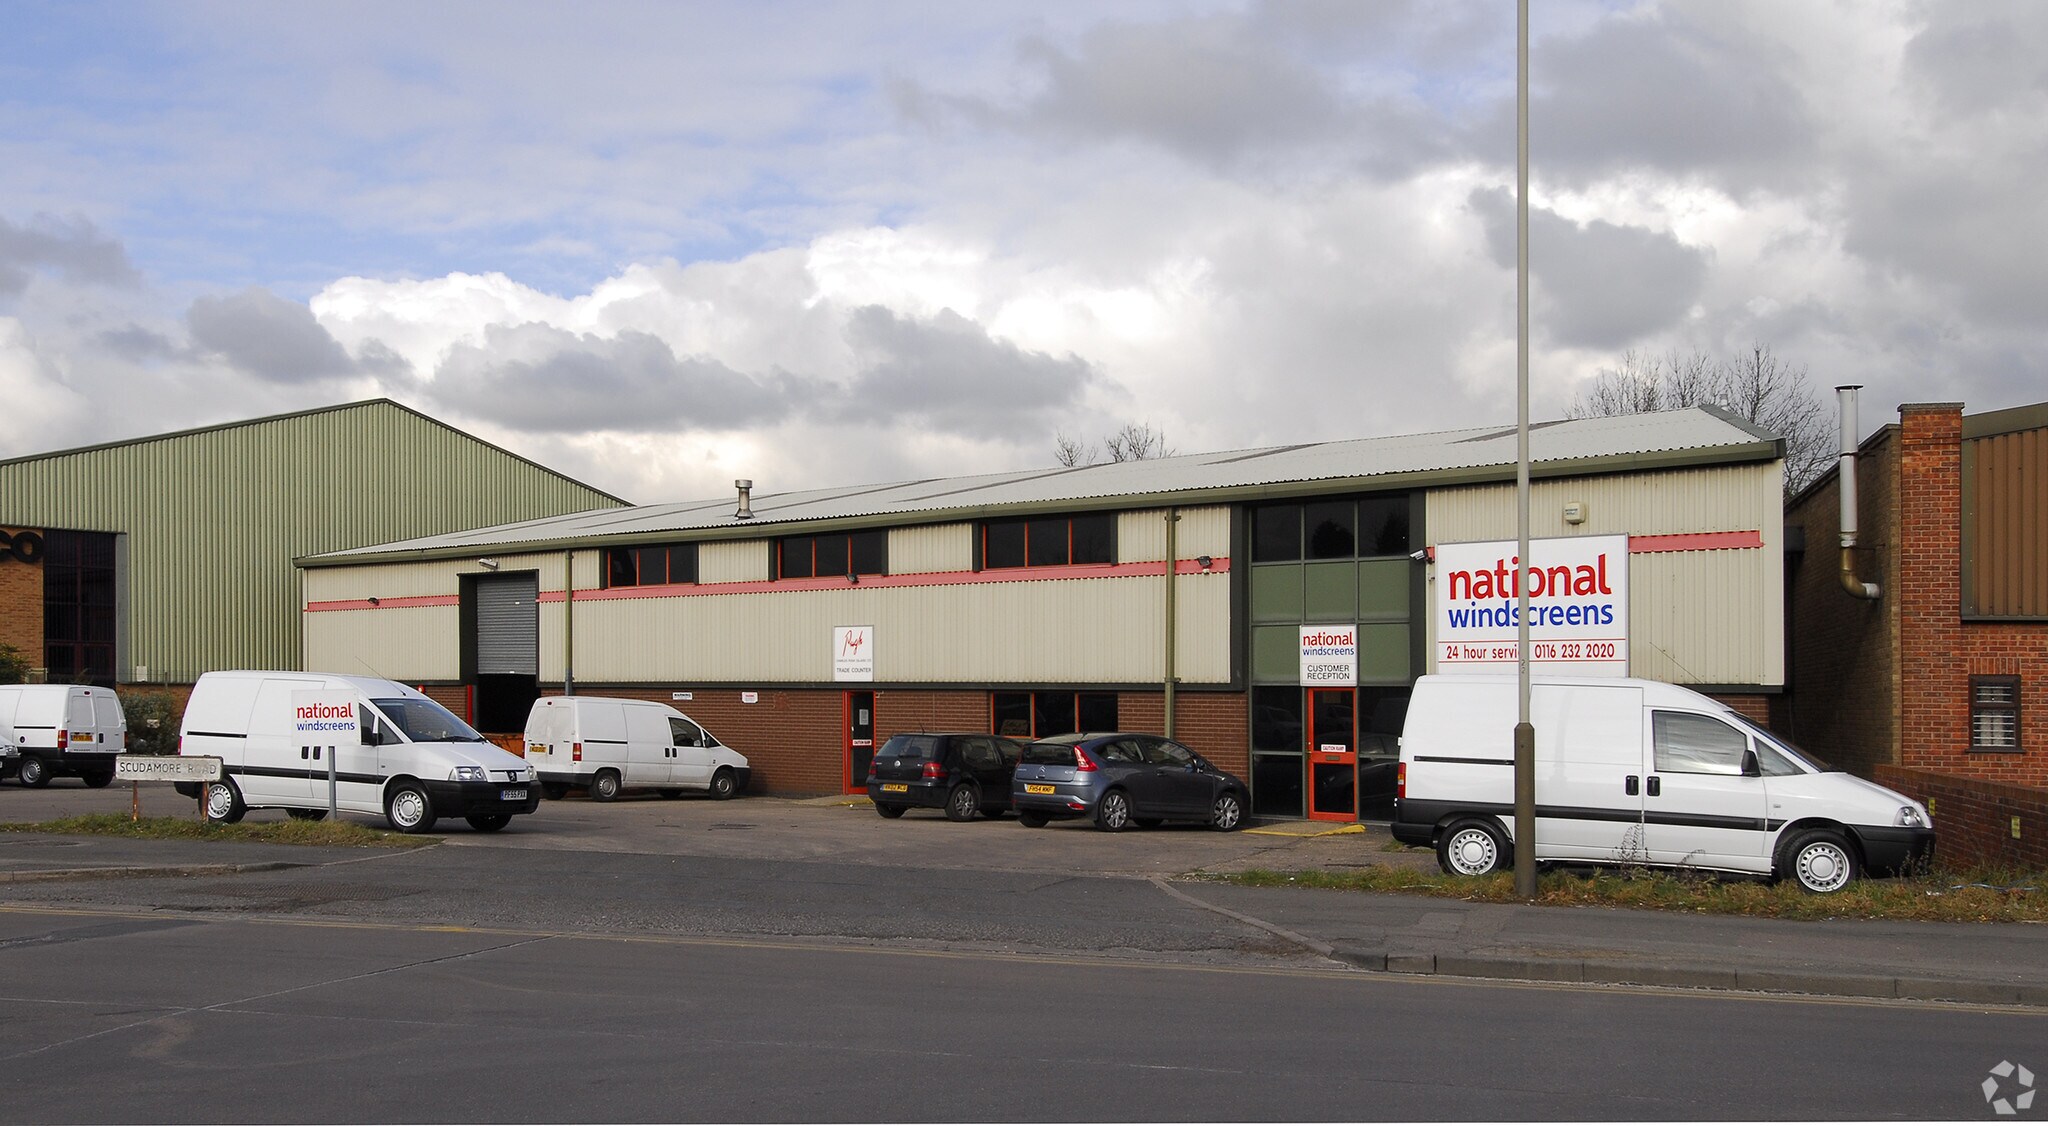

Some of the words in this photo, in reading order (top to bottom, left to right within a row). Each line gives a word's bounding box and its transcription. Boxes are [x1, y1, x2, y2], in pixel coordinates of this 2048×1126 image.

[1448, 553, 1612, 600] national
[1448, 600, 1614, 628] windscreens
[1303, 631, 1354, 646] national
[1303, 646, 1355, 656] windscreens
[1446, 645, 1459, 659] 24
[1463, 645, 1488, 659] hour
[1492, 643, 1519, 659] servi
[1534, 644, 1556, 658] 0116
[1561, 643, 1581, 658] 232
[1586, 643, 1615, 658] 2020
[1307, 664, 1350, 672] CUSTOMER
[1307, 672, 1350, 680] RECEPTION
[296, 702, 354, 719] national
[296, 720, 356, 731] windscreens
[120, 762, 181, 773] SCUDAMORE
